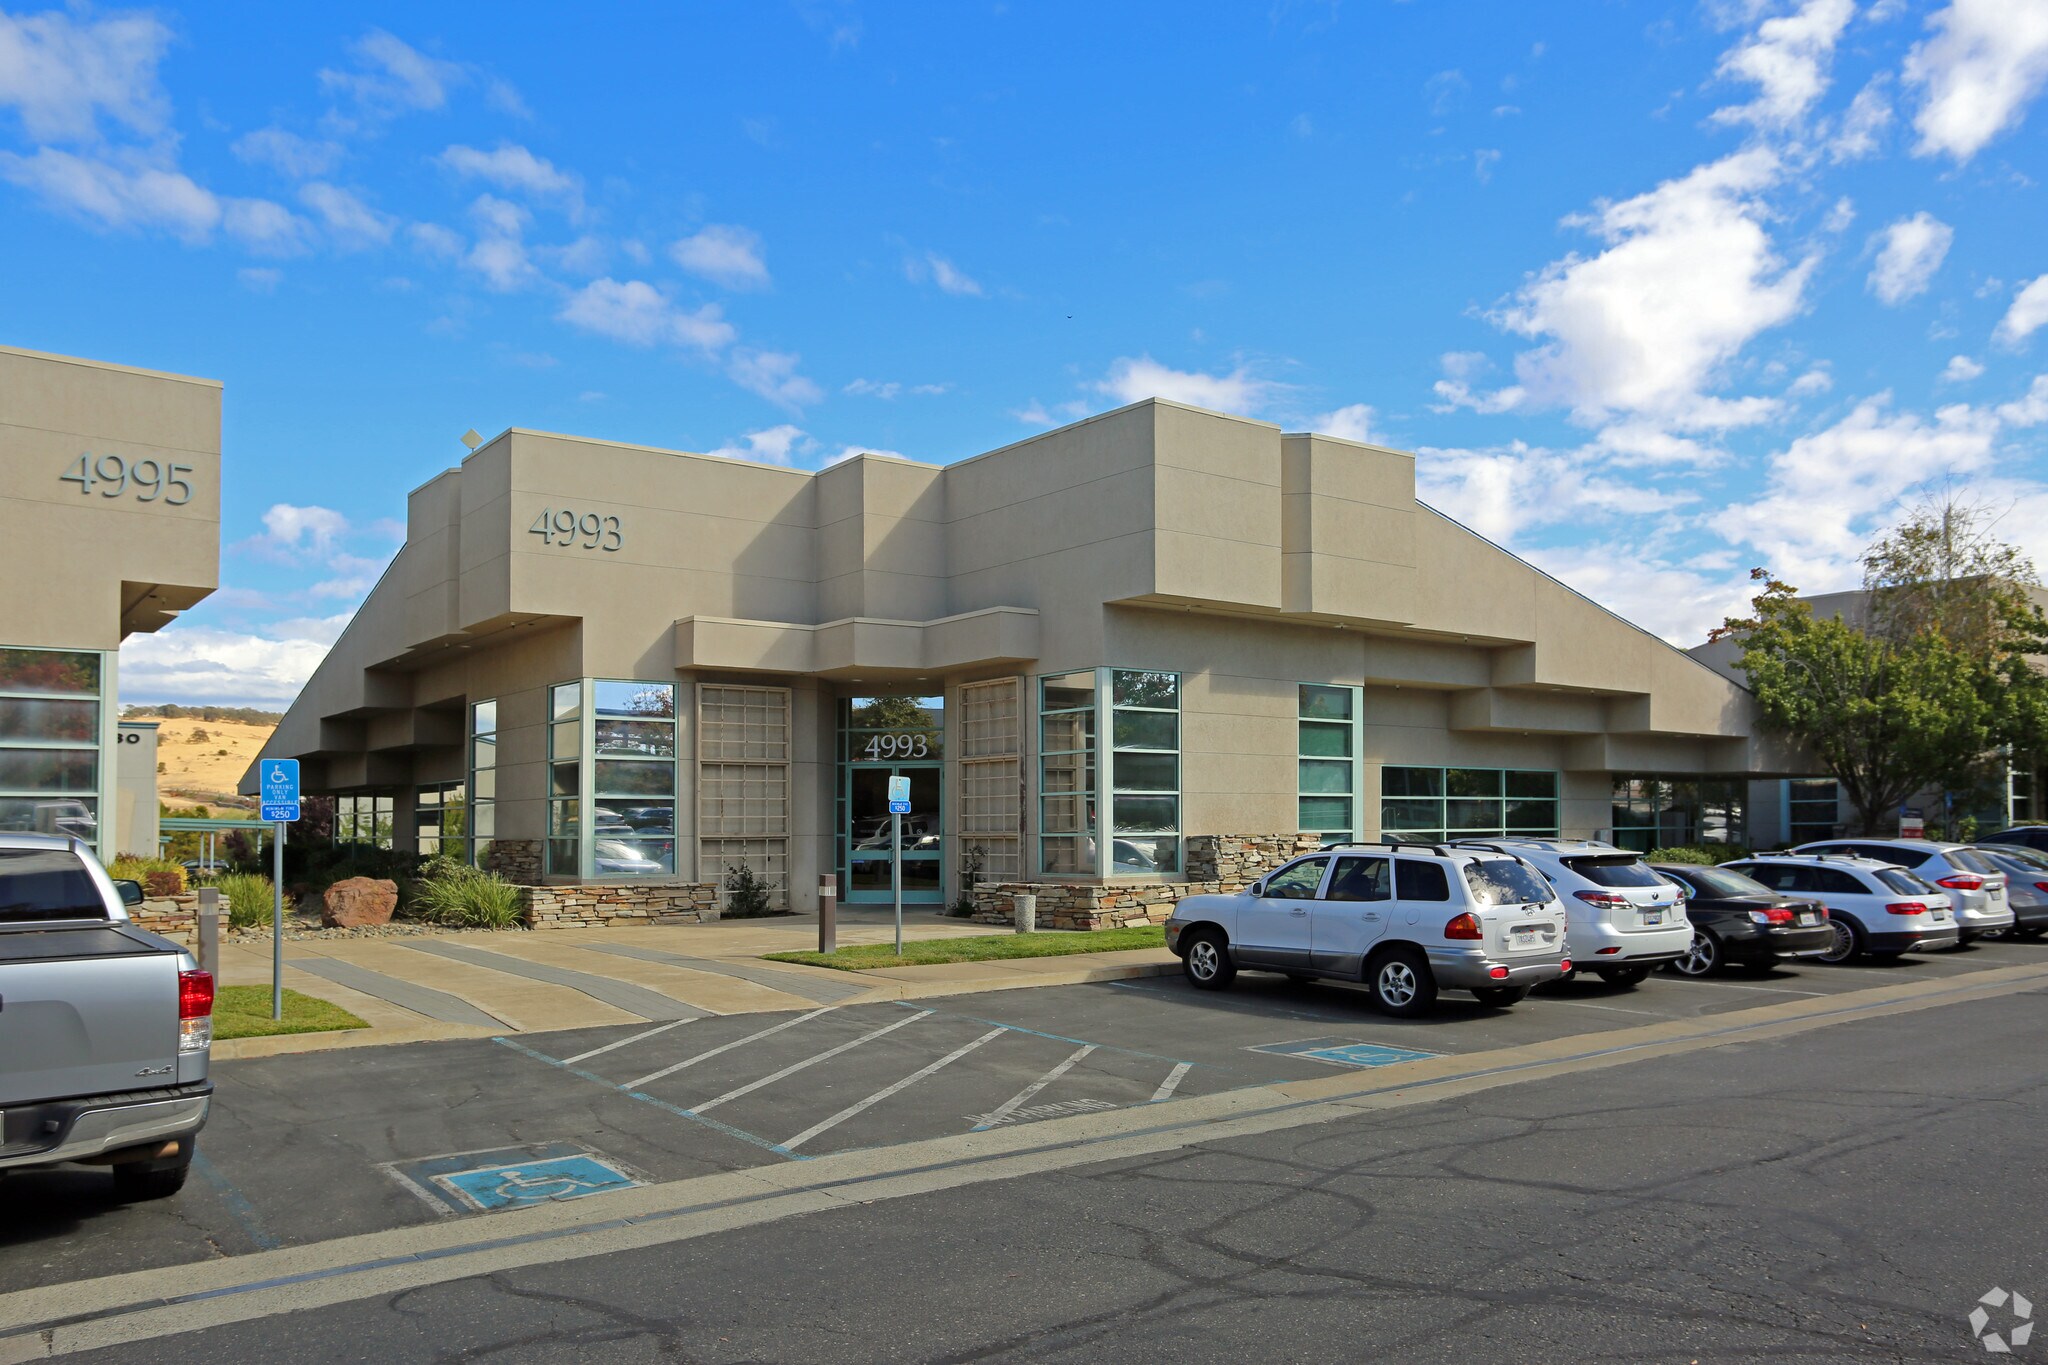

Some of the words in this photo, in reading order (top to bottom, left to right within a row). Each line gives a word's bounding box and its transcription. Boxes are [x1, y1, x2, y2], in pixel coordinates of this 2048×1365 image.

[60, 451, 195, 505] 4995
[528, 505, 624, 552] 4993
[864, 734, 928, 758] 4993
[271, 810, 290, 818] $250
